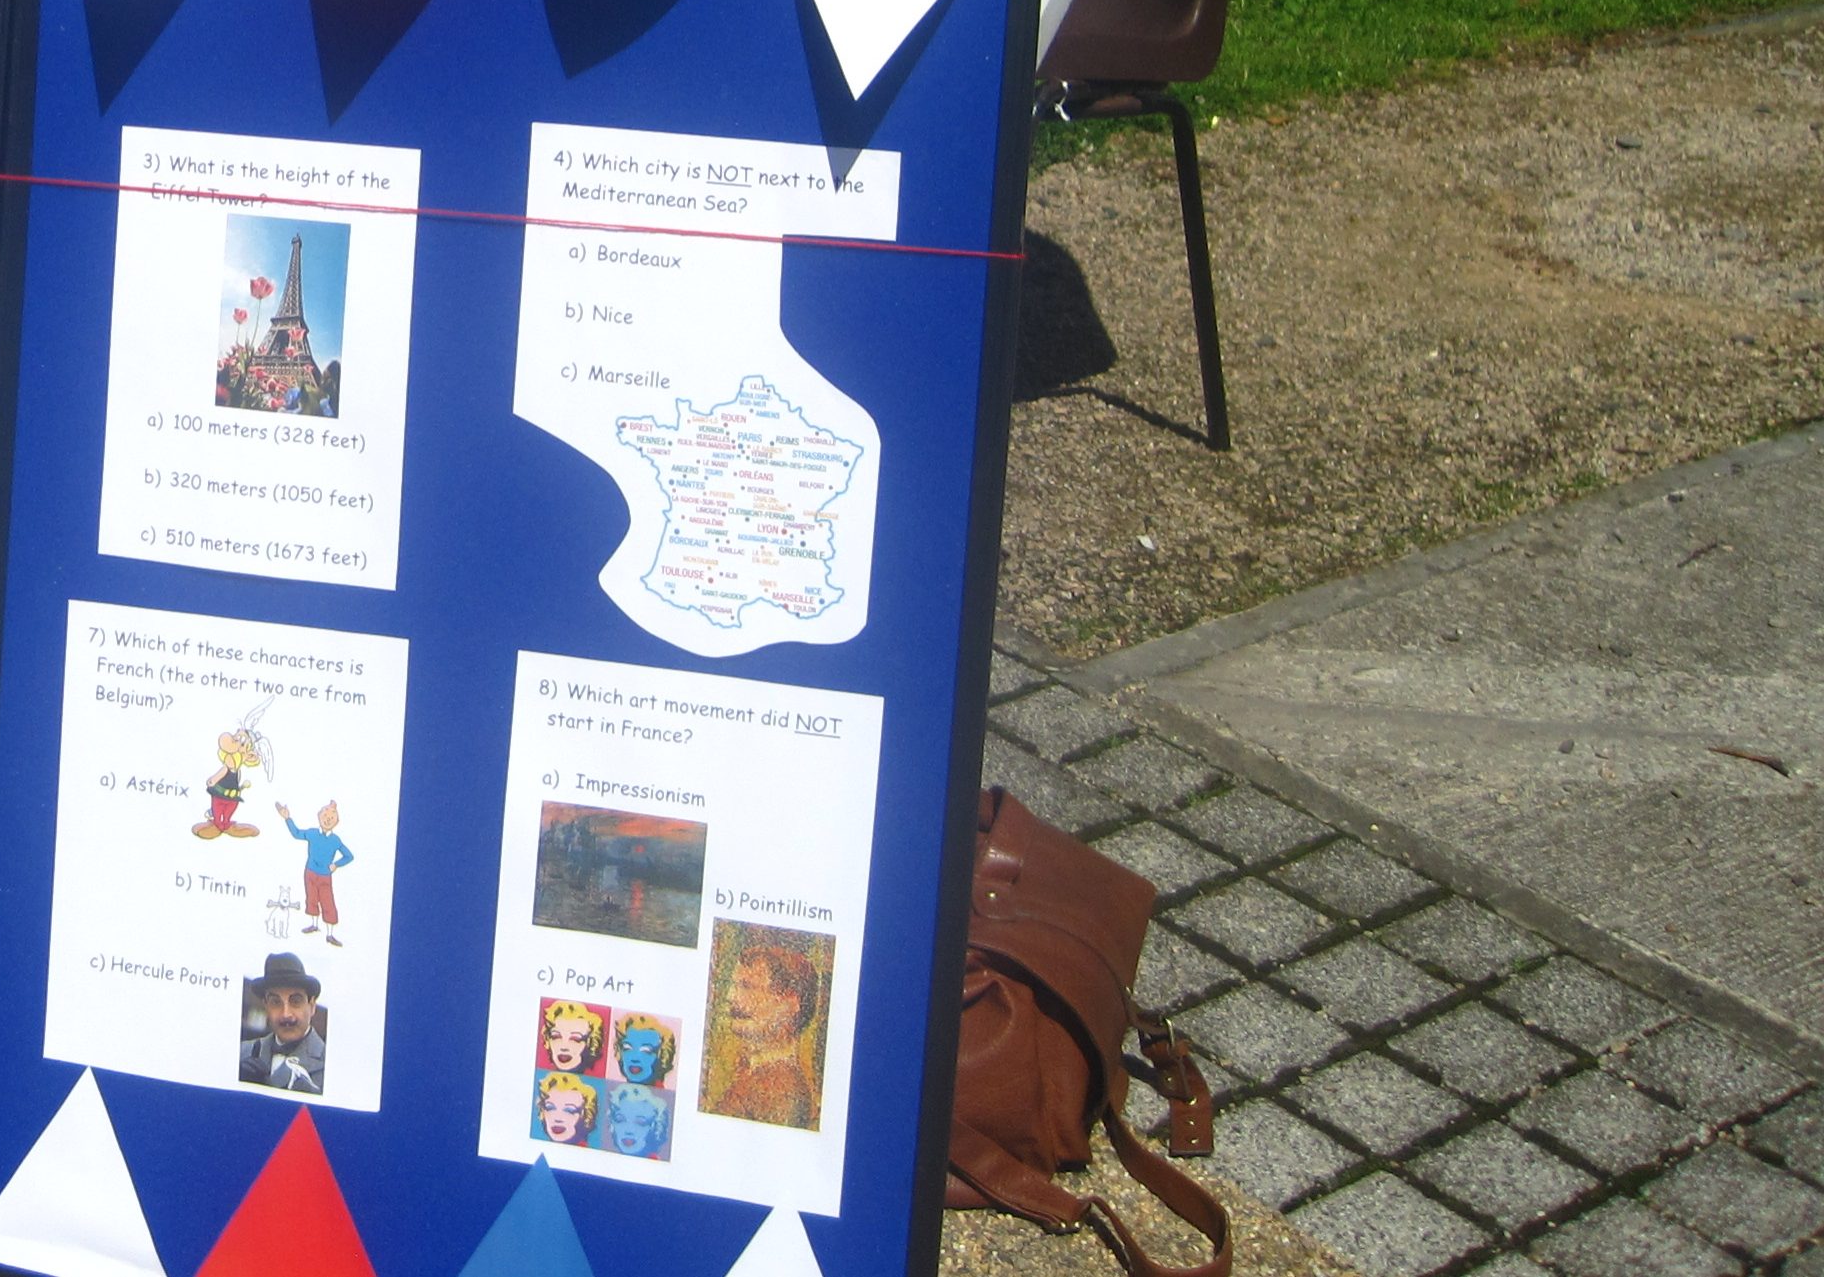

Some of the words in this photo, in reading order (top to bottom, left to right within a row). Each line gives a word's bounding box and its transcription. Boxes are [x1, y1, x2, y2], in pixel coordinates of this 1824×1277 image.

[143, 152, 161, 173] 3)
[169, 155, 216, 175] What
[222, 160, 234, 177] is
[240, 161, 269, 180] the
[275, 163, 331, 189] height
[336, 169, 356, 188] of
[361, 171, 390, 190] the
[553, 150, 573, 172] 4)
[583, 152, 639, 175] Which
[645, 161, 680, 180] city
[687, 161, 701, 180] is
[706, 164, 753, 184] NOT
[759, 169, 800, 188] next
[807, 174, 826, 192] to
[833, 175, 864, 195] the
[562, 181, 697, 210] Mediterranean
[703, 194, 748, 214] Sea?
[738, 432, 762, 443] PARIS
[792, 450, 843, 463] STRASBOURG
[676, 480, 705, 490] NANTES
[758, 523, 779, 534] LYON
[779, 547, 825, 560] GRENOBLE
[661, 566, 704, 580] TOULOUSE
[88, 626, 106, 648] 7)
[114, 630, 166, 652] Which
[171, 638, 191, 656] of
[196, 640, 244, 662] these
[249, 647, 344, 674] characters
[349, 658, 364, 676] is
[538, 679, 558, 700] 8)
[568, 681, 623, 706] Which
[629, 694, 657, 711] art
[664, 698, 755, 724] movement
[761, 710, 789, 729] did
[795, 712, 843, 734] NOT
[547, 712, 594, 731] start
[600, 721, 616, 735] in
[621, 719, 694, 744] France?
[99, 771, 116, 791] a)
[126, 775, 189, 798] Astérix
[175, 871, 193, 892] b)
[198, 874, 246, 898] Tintin
[89, 953, 106, 973] c)
[110, 955, 175, 981] Hercule
[179, 966, 230, 990] Poirot
